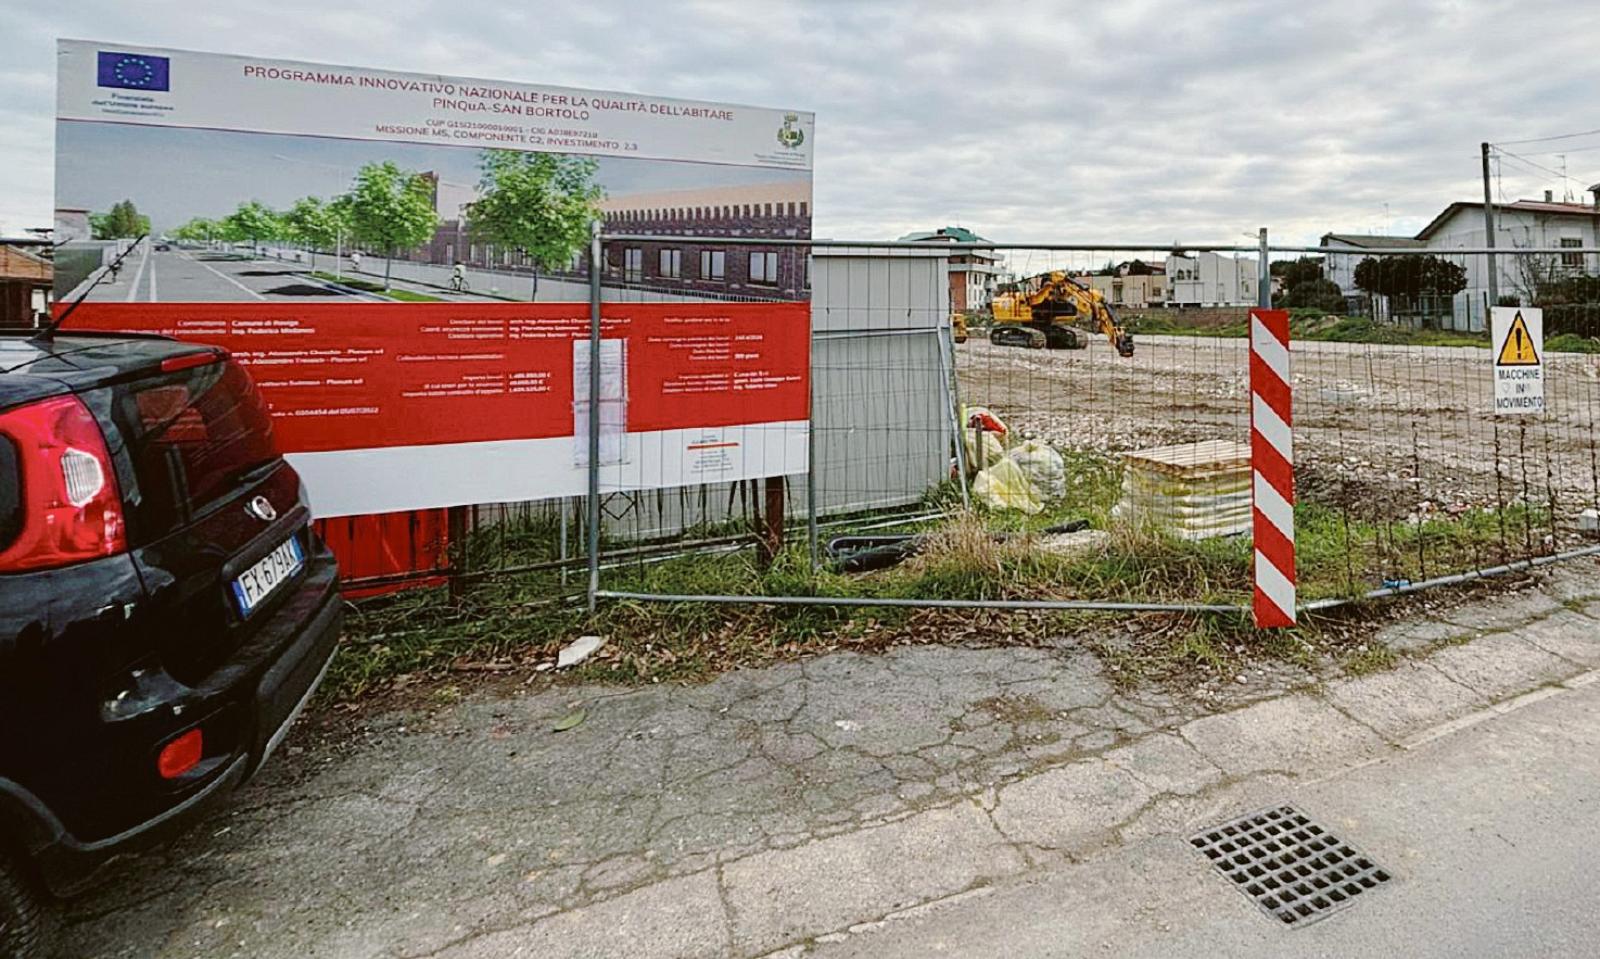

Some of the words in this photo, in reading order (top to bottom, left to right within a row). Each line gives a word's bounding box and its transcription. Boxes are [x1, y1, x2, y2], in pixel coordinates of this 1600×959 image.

[244, 65, 354, 86] PROGRAMMA
[359, 76, 455, 96] INNOVATIVO
[459, 87, 538, 103] NAZIONALE
[542, 93, 568, 105] PER
[571, 96, 588, 107] LA
[591, 98, 647, 113] QUALITÀ
[650, 103, 734, 121] DELL'ABITARE
[525, 106, 590, 121] BORTOLO
[376, 124, 429, 135] MISSIONE
[453, 128, 525, 143] COMPONENTE
[546, 137, 619, 150] INVESTIMENTO
[1498, 369, 1540, 380] MACCHINE
[1515, 383, 1525, 394] IN
[1496, 396, 1544, 408] MOVIMENTO
[241, 567, 266, 604] FX
